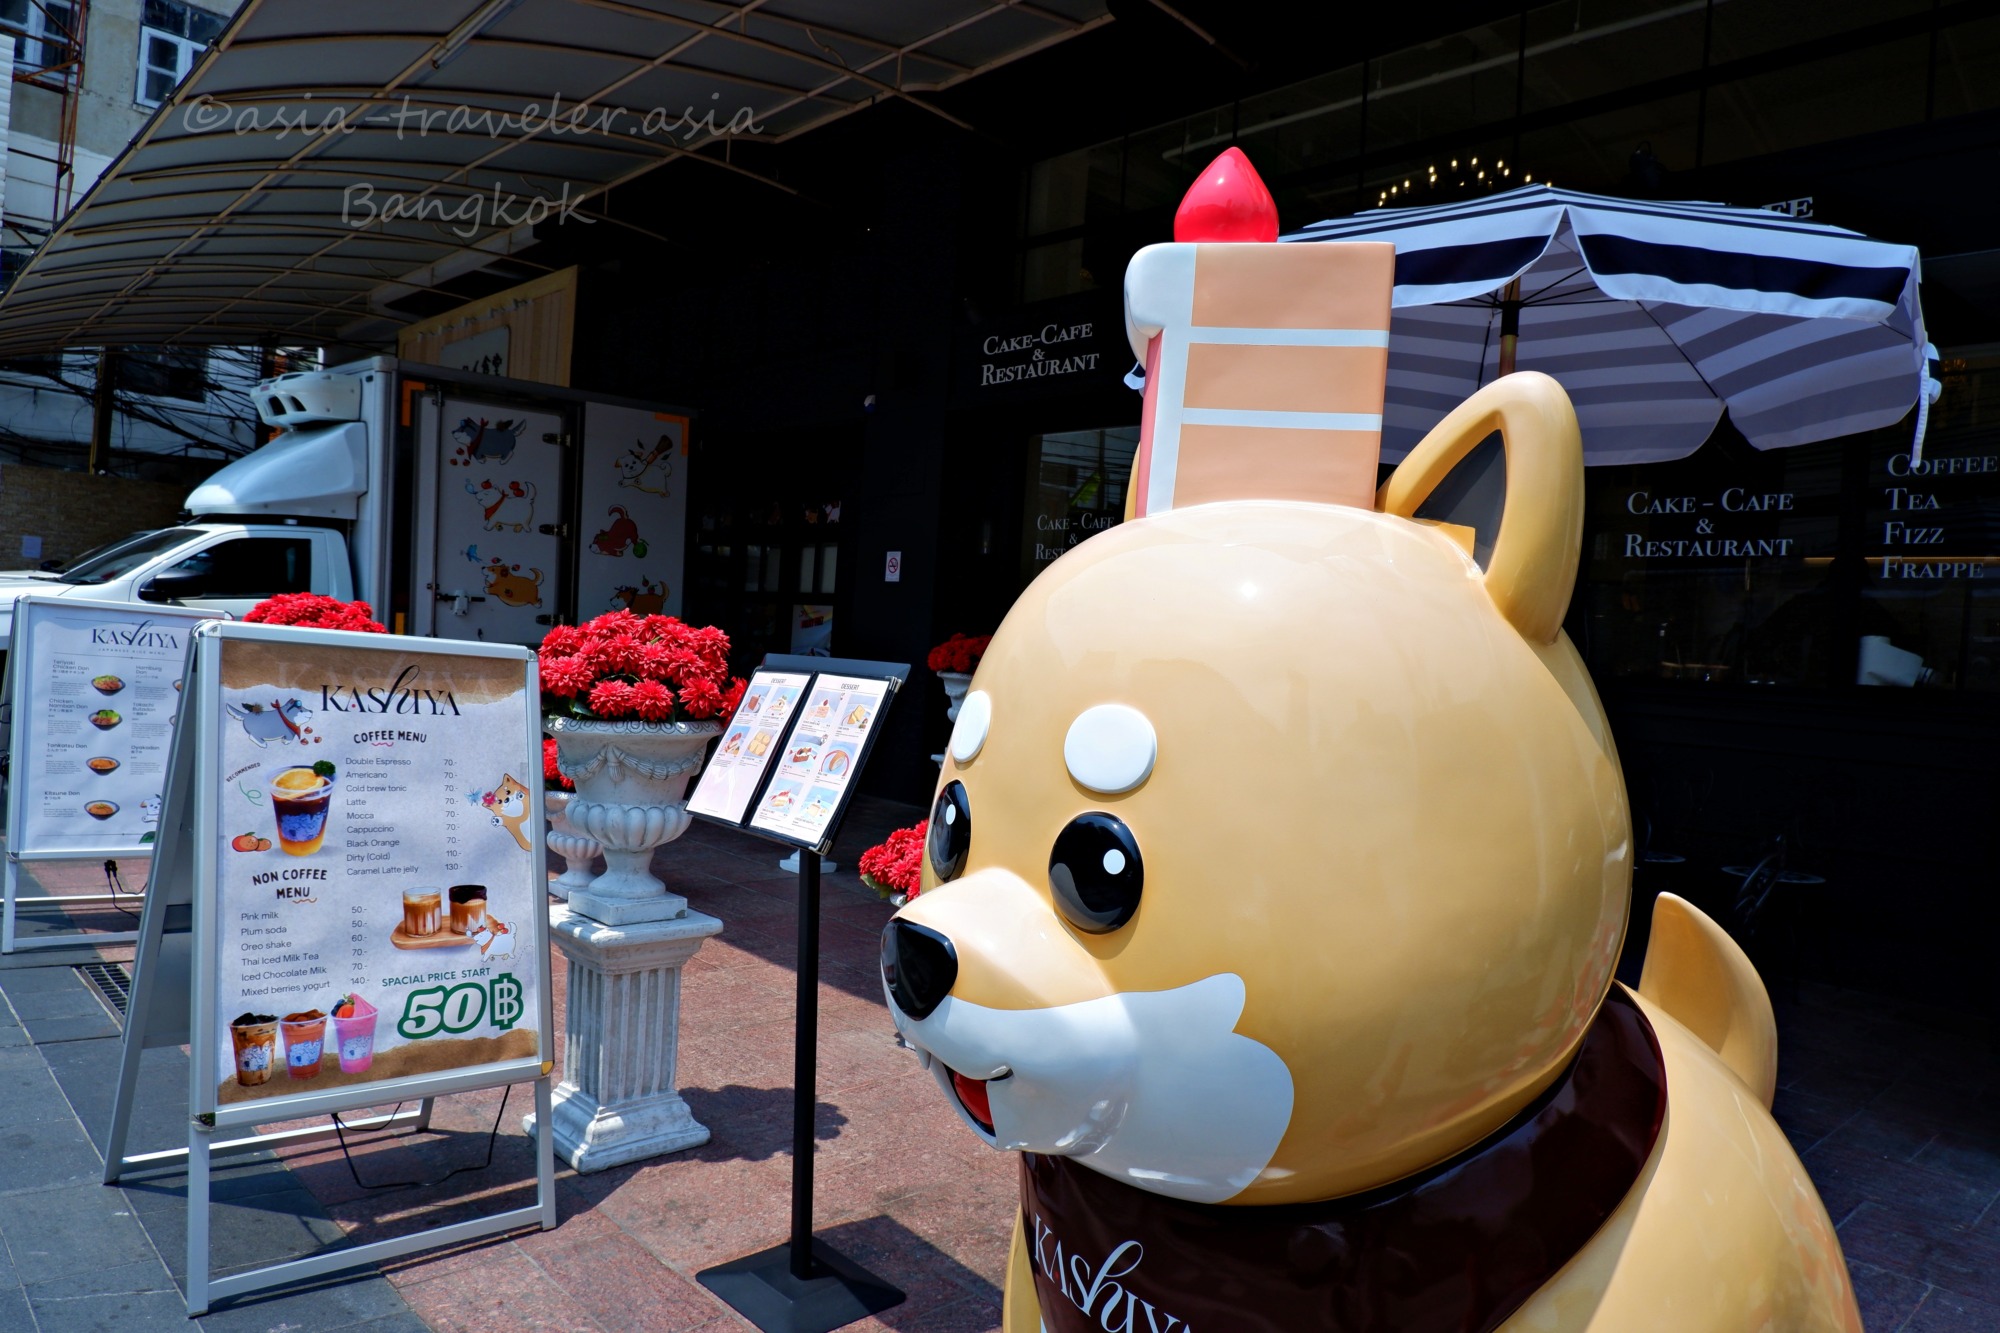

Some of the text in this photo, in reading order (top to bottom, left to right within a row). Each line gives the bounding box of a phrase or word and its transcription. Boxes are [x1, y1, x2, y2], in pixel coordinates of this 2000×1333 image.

[1032, 349, 1045, 360] &
[980, 354, 1100, 385] RESTAURANT
[1887, 453, 1998, 477] COFFEE
[1627, 491, 1696, 515] CAKE
[1721, 487, 1794, 512] CAFE
[1885, 487, 1941, 511] TEA
[1696, 517, 1715, 534] &
[1069, 532, 1077, 545] &
[1883, 521, 1945, 545] FIZZ
[1624, 534, 1793, 558] RESTAURANT
[1881, 555, 1984, 579] FRAPPE
[353, 729, 427, 744] COFFEE MENU
[345, 757, 412, 768] Double Espresso
[226, 762, 261, 782] RECOMMENDED
[345, 770, 388, 779] Americano
[345, 784, 407, 793] Cold brew tonic
[346, 797, 366, 806] Latte
[346, 811, 374, 820] Mocca
[346, 825, 395, 835] Cappuccino
[346, 838, 400, 849] Black Orange
[346, 851, 391, 862] Dirty (Cold)
[347, 864, 419, 876] Caramel Latte jelly
[253, 869, 328, 886] NON COFFEE
[276, 886, 310, 899] MENU
[241, 912, 259, 920] Pink
[241, 926, 287, 936] Plum soda
[241, 943, 263, 951] Oreo
[241, 958, 259, 966] Thai
[261, 956, 281, 964] Iced
[283, 954, 300, 962] Milk
[263, 969, 308, 979] Chocolate
[310, 967, 327, 975] Milk
[381, 967, 490, 987] SPACIAL PRICE START
[241, 981, 330, 997] Mixed berries yogurt
